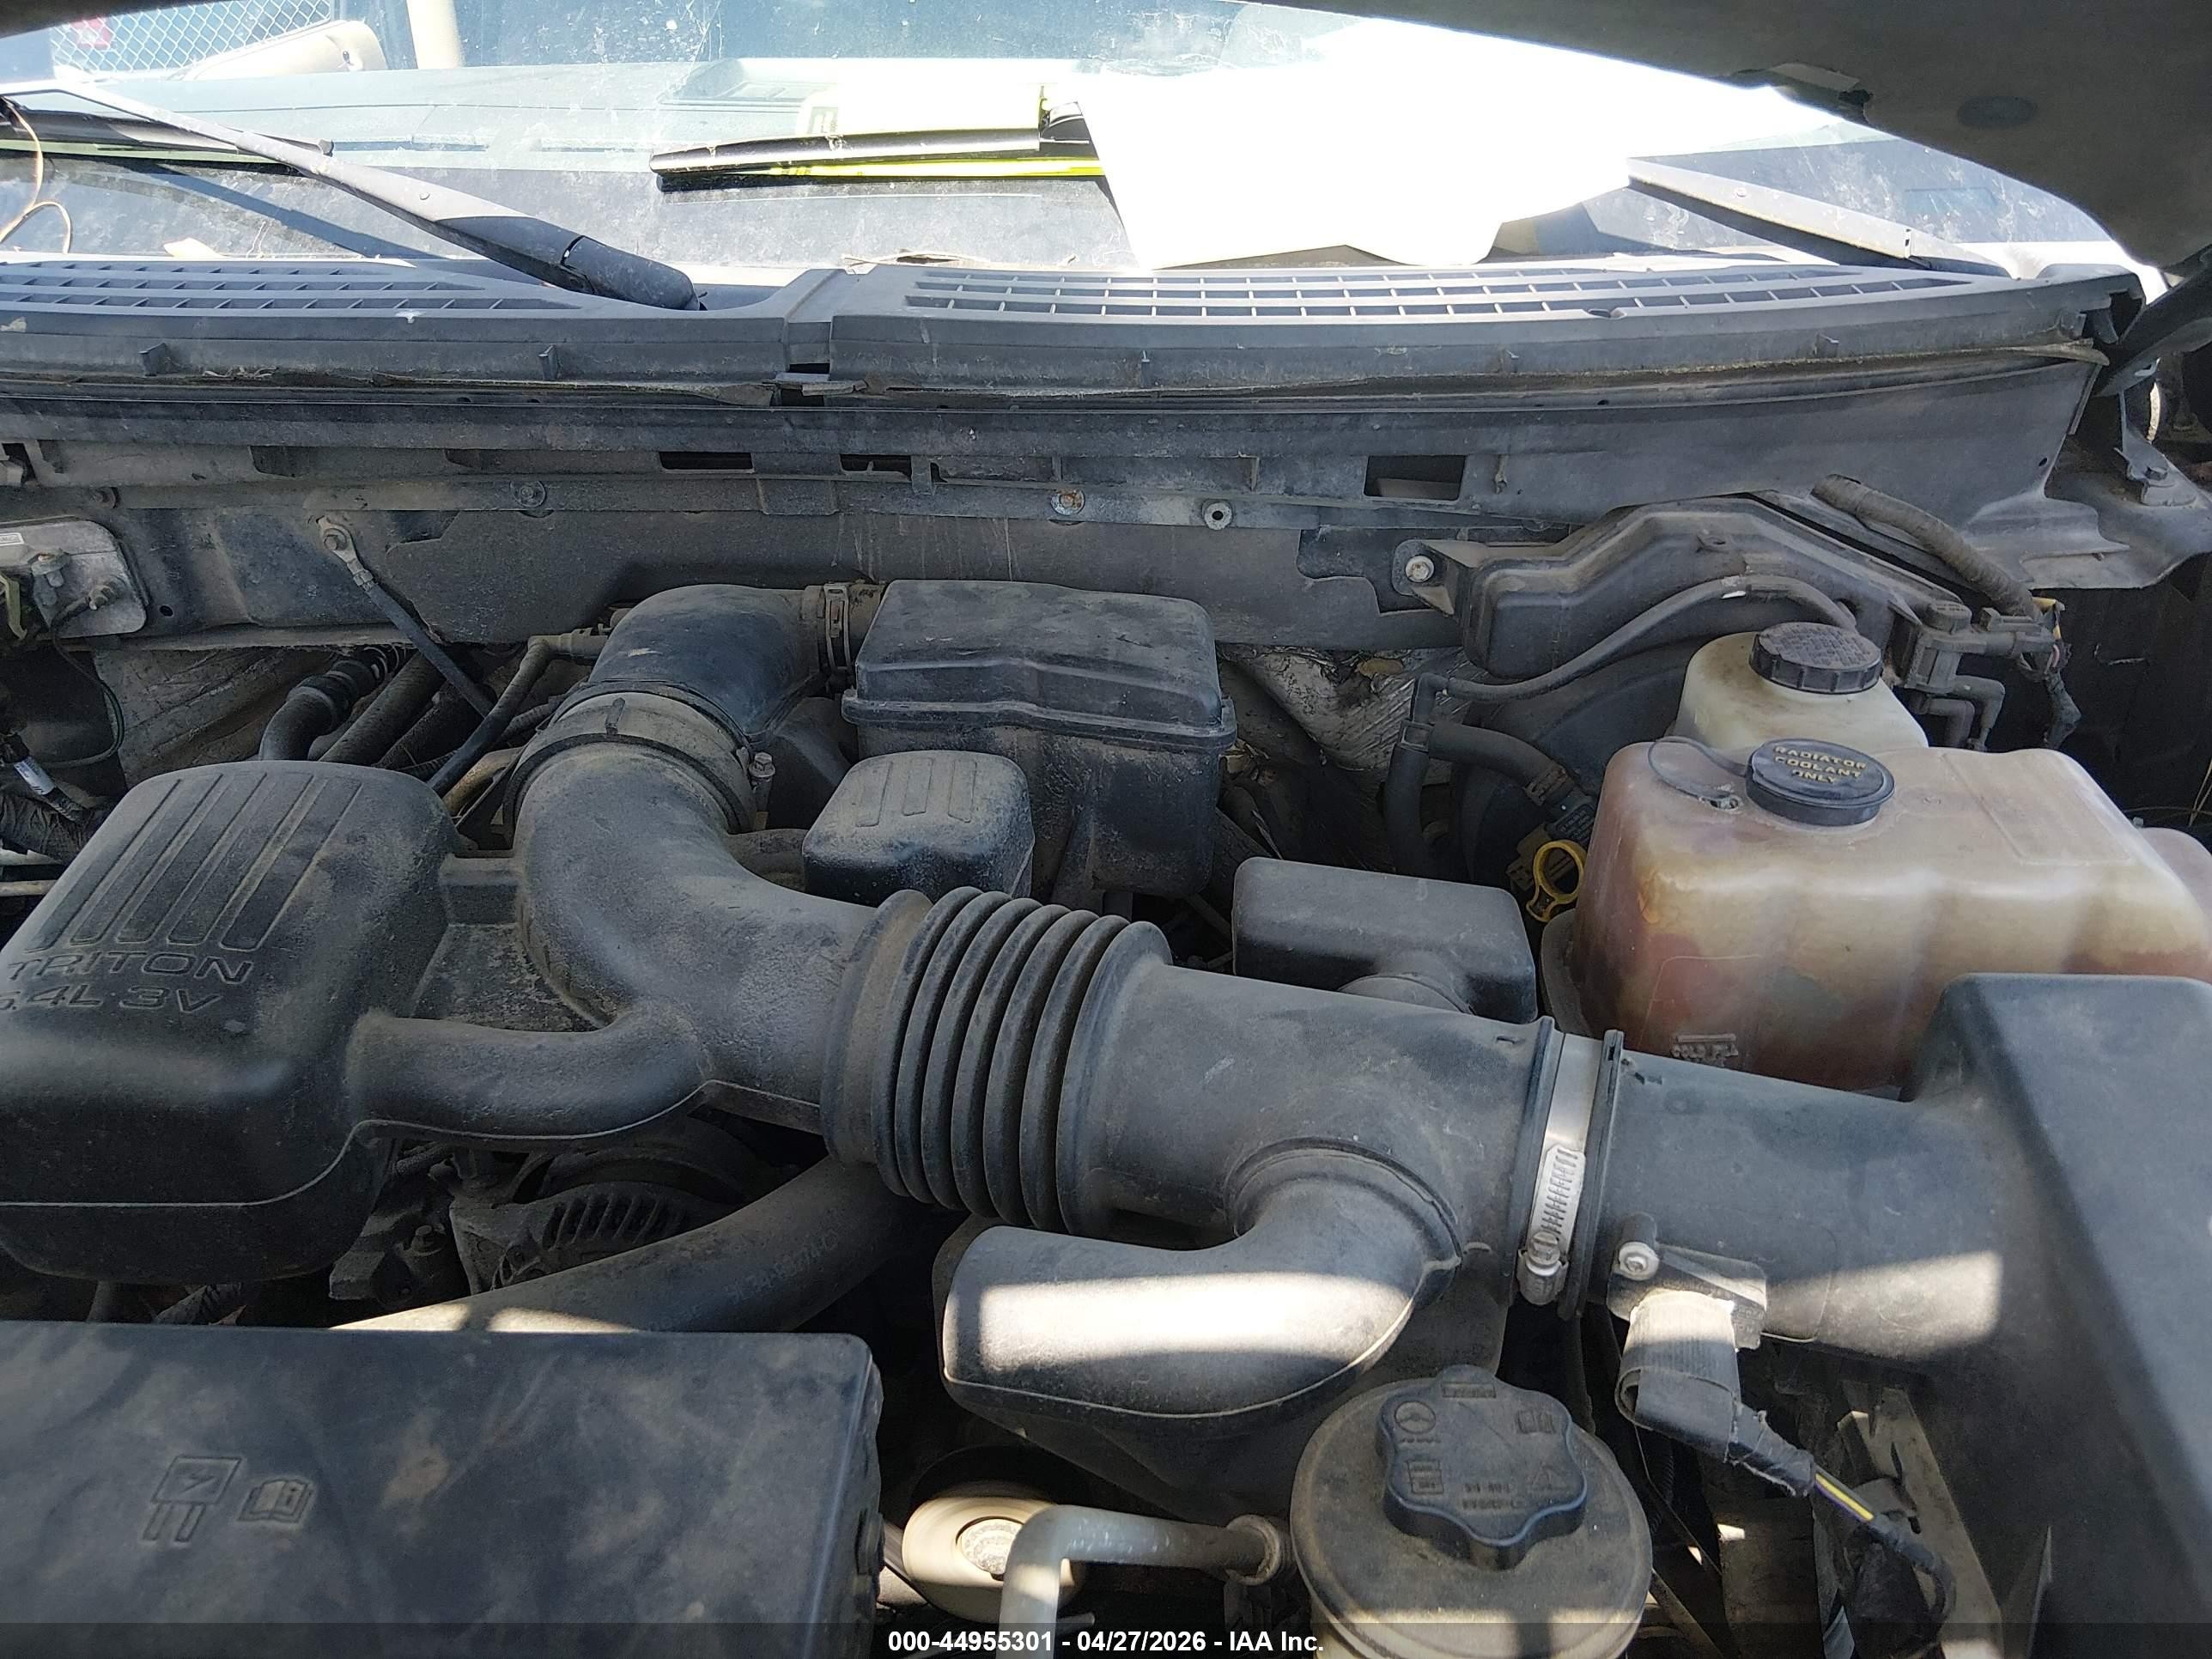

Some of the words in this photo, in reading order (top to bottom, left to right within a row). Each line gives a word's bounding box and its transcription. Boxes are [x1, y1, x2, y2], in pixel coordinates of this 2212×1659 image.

[1774, 745, 1867, 770] RADIATOR
[1774, 756, 1863, 779] COOLANT
[9, 950, 254, 985] TRITON
[119, 985, 222, 1013] 3V
